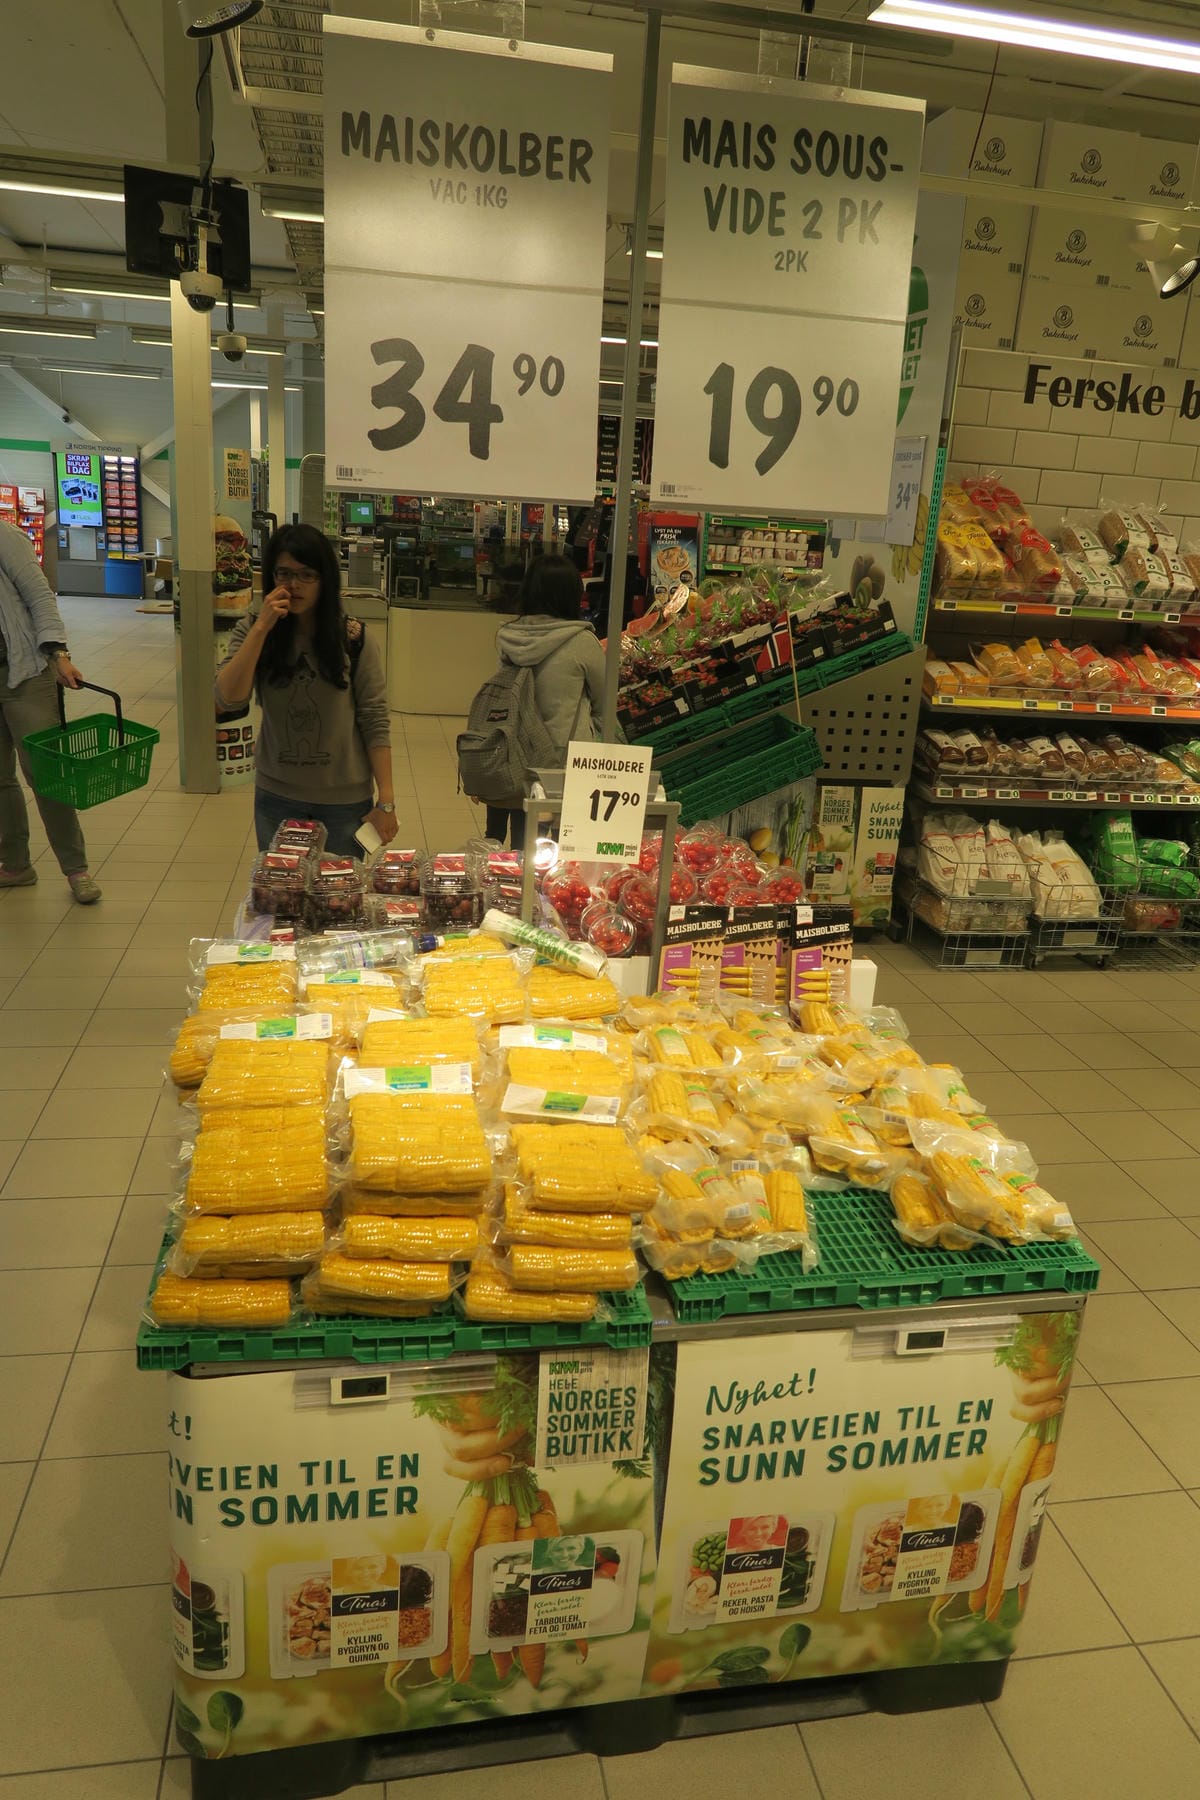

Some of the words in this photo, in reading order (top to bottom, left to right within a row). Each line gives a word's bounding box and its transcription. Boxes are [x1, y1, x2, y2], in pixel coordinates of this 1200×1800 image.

[341, 110, 594, 184] MAISKOLBER
[682, 117, 776, 171] MAIS
[790, 128, 904, 181] SOUS-
[973, 160, 1012, 176] Bakehuset
[1069, 172, 1107, 188] Bakehuset
[430, 178, 467, 206] VAC
[474, 185, 508, 209] 1KG
[1149, 185, 1187, 200] Bakehuset
[704, 183, 785, 237] VIDE
[801, 199, 823, 240] 2
[836, 197, 883, 244] PK
[964, 239, 1002, 254] Bakehuset
[774, 249, 808, 273] 2PK
[1055, 252, 1092, 267] Bakehuset
[1042, 327, 1079, 342] Bakehuset
[1123, 336, 1158, 351] Bakehuset
[1023, 364, 1165, 417] Ferske
[97, 445, 122, 453] TIPPING
[67, 454, 90, 462] SKRAP
[72, 467, 90, 475] DAG
[573, 757, 644, 773] MAISHOLDERE
[590, 789, 620, 822] 17
[621, 792, 641, 806] 90
[823, 807, 850, 815] SOMMER
[822, 814, 849, 823] BUTIKK
[596, 842, 625, 856] KIWI
[667, 920, 722, 936] MAISHOLDERE
[726, 920, 774, 935] AISHOLDERE
[796, 923, 850, 939] MAISHOLDERE
[549, 1361, 579, 1375] KIWI
[549, 1378, 578, 1390] HELE
[548, 1386, 637, 1413] NORGES
[705, 1368, 816, 1416] Nyhet!
[547, 1409, 635, 1434] SOMMER
[702, 1410, 880, 1450] SNARVEIEN
[897, 1404, 941, 1431] TIL
[957, 1398, 994, 1425] EN
[546, 1430, 633, 1458] BUTIKK
[698, 1448, 806, 1486] SUNN
[826, 1427, 989, 1473] SOMMER
[300, 1458, 358, 1487] TIL
[378, 1452, 420, 1483] EN
[219, 1485, 419, 1527] SOMMER
[907, 1532, 946, 1548] Tinas
[731, 1554, 773, 1569] Tinas
[907, 1568, 936, 1580] KYLLING
[538, 1574, 582, 1590] Tinas
[897, 1578, 930, 1589] BYGGRYN
[930, 1577, 941, 1585] OG
[905, 1587, 931, 1597] QUINOA
[340, 1595, 386, 1613] Tinas
[722, 1598, 749, 1608] REKER,
[751, 1595, 774, 1604] PASTA
[728, 1607, 739, 1616] OG
[740, 1604, 765, 1615] HOISIN
[529, 1626, 548, 1635] FETA
[561, 1621, 587, 1631] TOMAT
[535, 1614, 580, 1627] TABBOULEH,
[347, 1634, 382, 1646] KYLLING
[337, 1644, 377, 1656] BYGGRYN
[377, 1642, 390, 1651] OG
[349, 1653, 380, 1664] QUINOA
